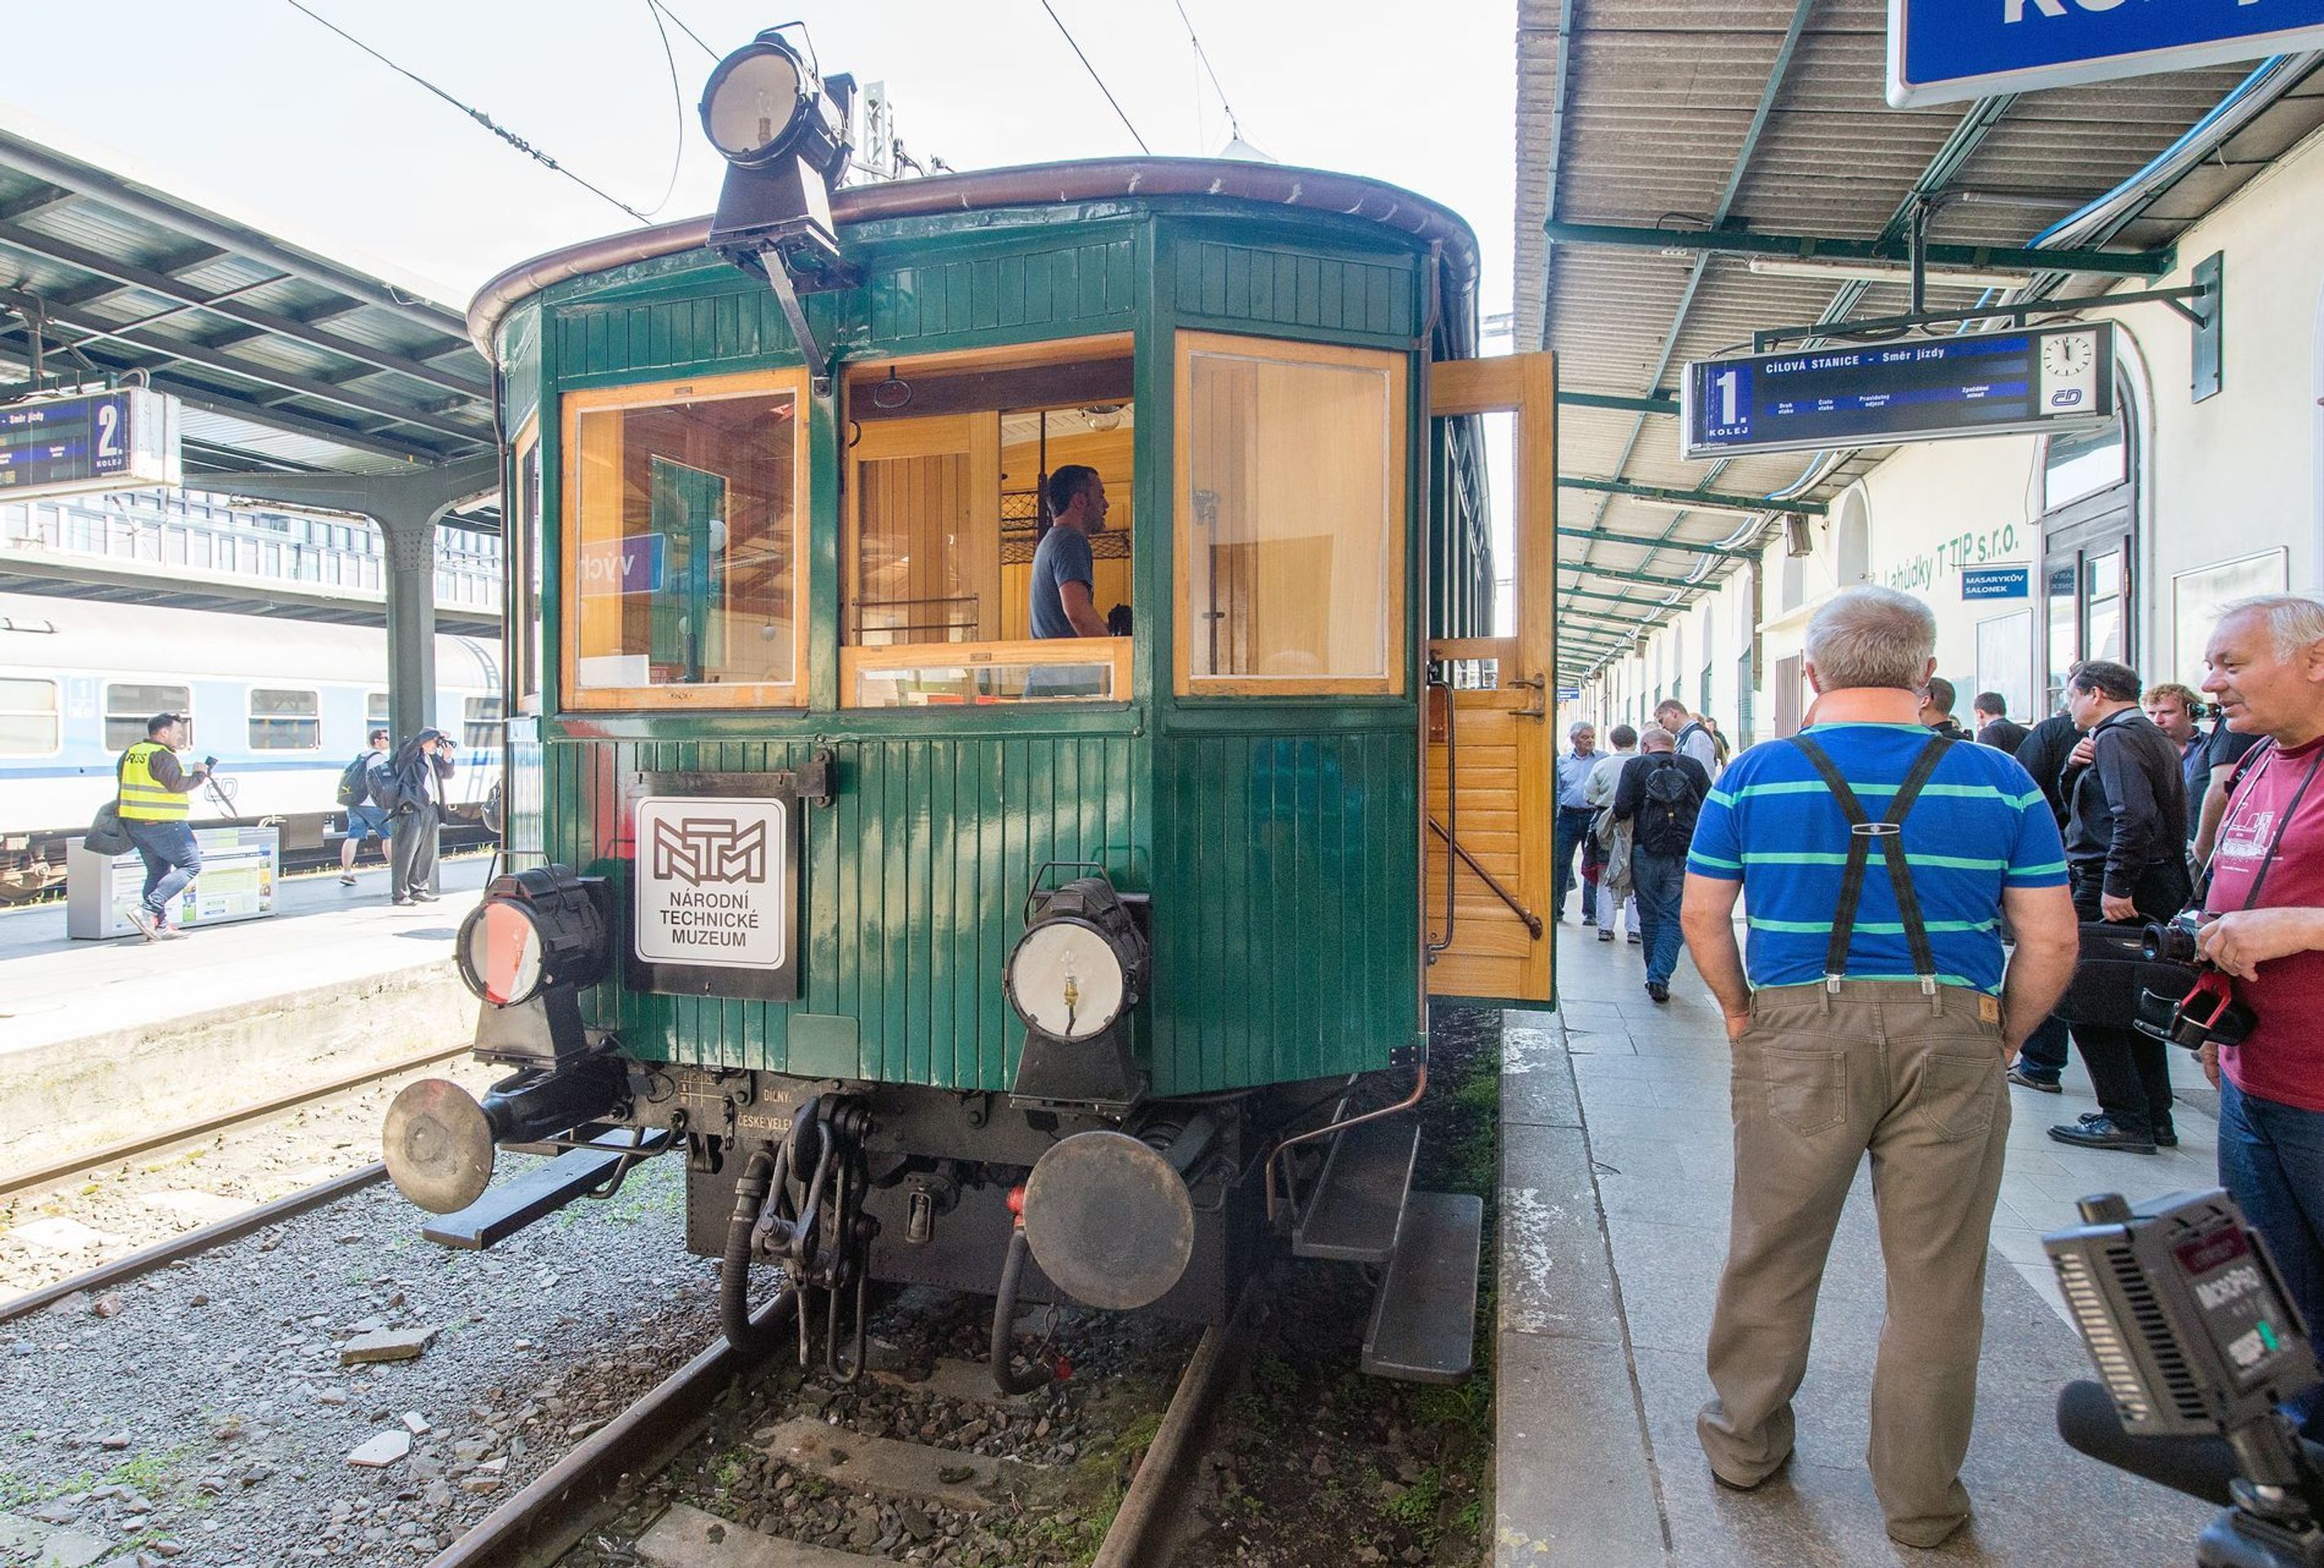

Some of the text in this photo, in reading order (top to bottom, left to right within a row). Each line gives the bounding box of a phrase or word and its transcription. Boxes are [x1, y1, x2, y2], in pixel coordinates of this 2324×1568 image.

[1765, 359, 1806, 374] CÍLOVÁ
[1811, 355, 1859, 370] STANICE
[1882, 351, 1912, 363] Směr
[1916, 348, 1945, 361] jízdy
[1716, 371, 1747, 425] 1.
[99, 404, 123, 457] 2.
[1709, 427, 1749, 437] KOLEJ
[96, 458, 122, 468] KOLEJ
[1949, 532, 1973, 572] TIP
[1978, 523, 2019, 562] s.r.o.
[1966, 573, 2024, 584] MASARYKŮV
[1966, 586, 2008, 595] SALONEK
[670, 888, 749, 909] NÁRODNÍ
[660, 909, 759, 929] TECHNICKÉ
[672, 929, 746, 947] MUZEUM
[737, 1111, 765, 1129] ČESKÉ
